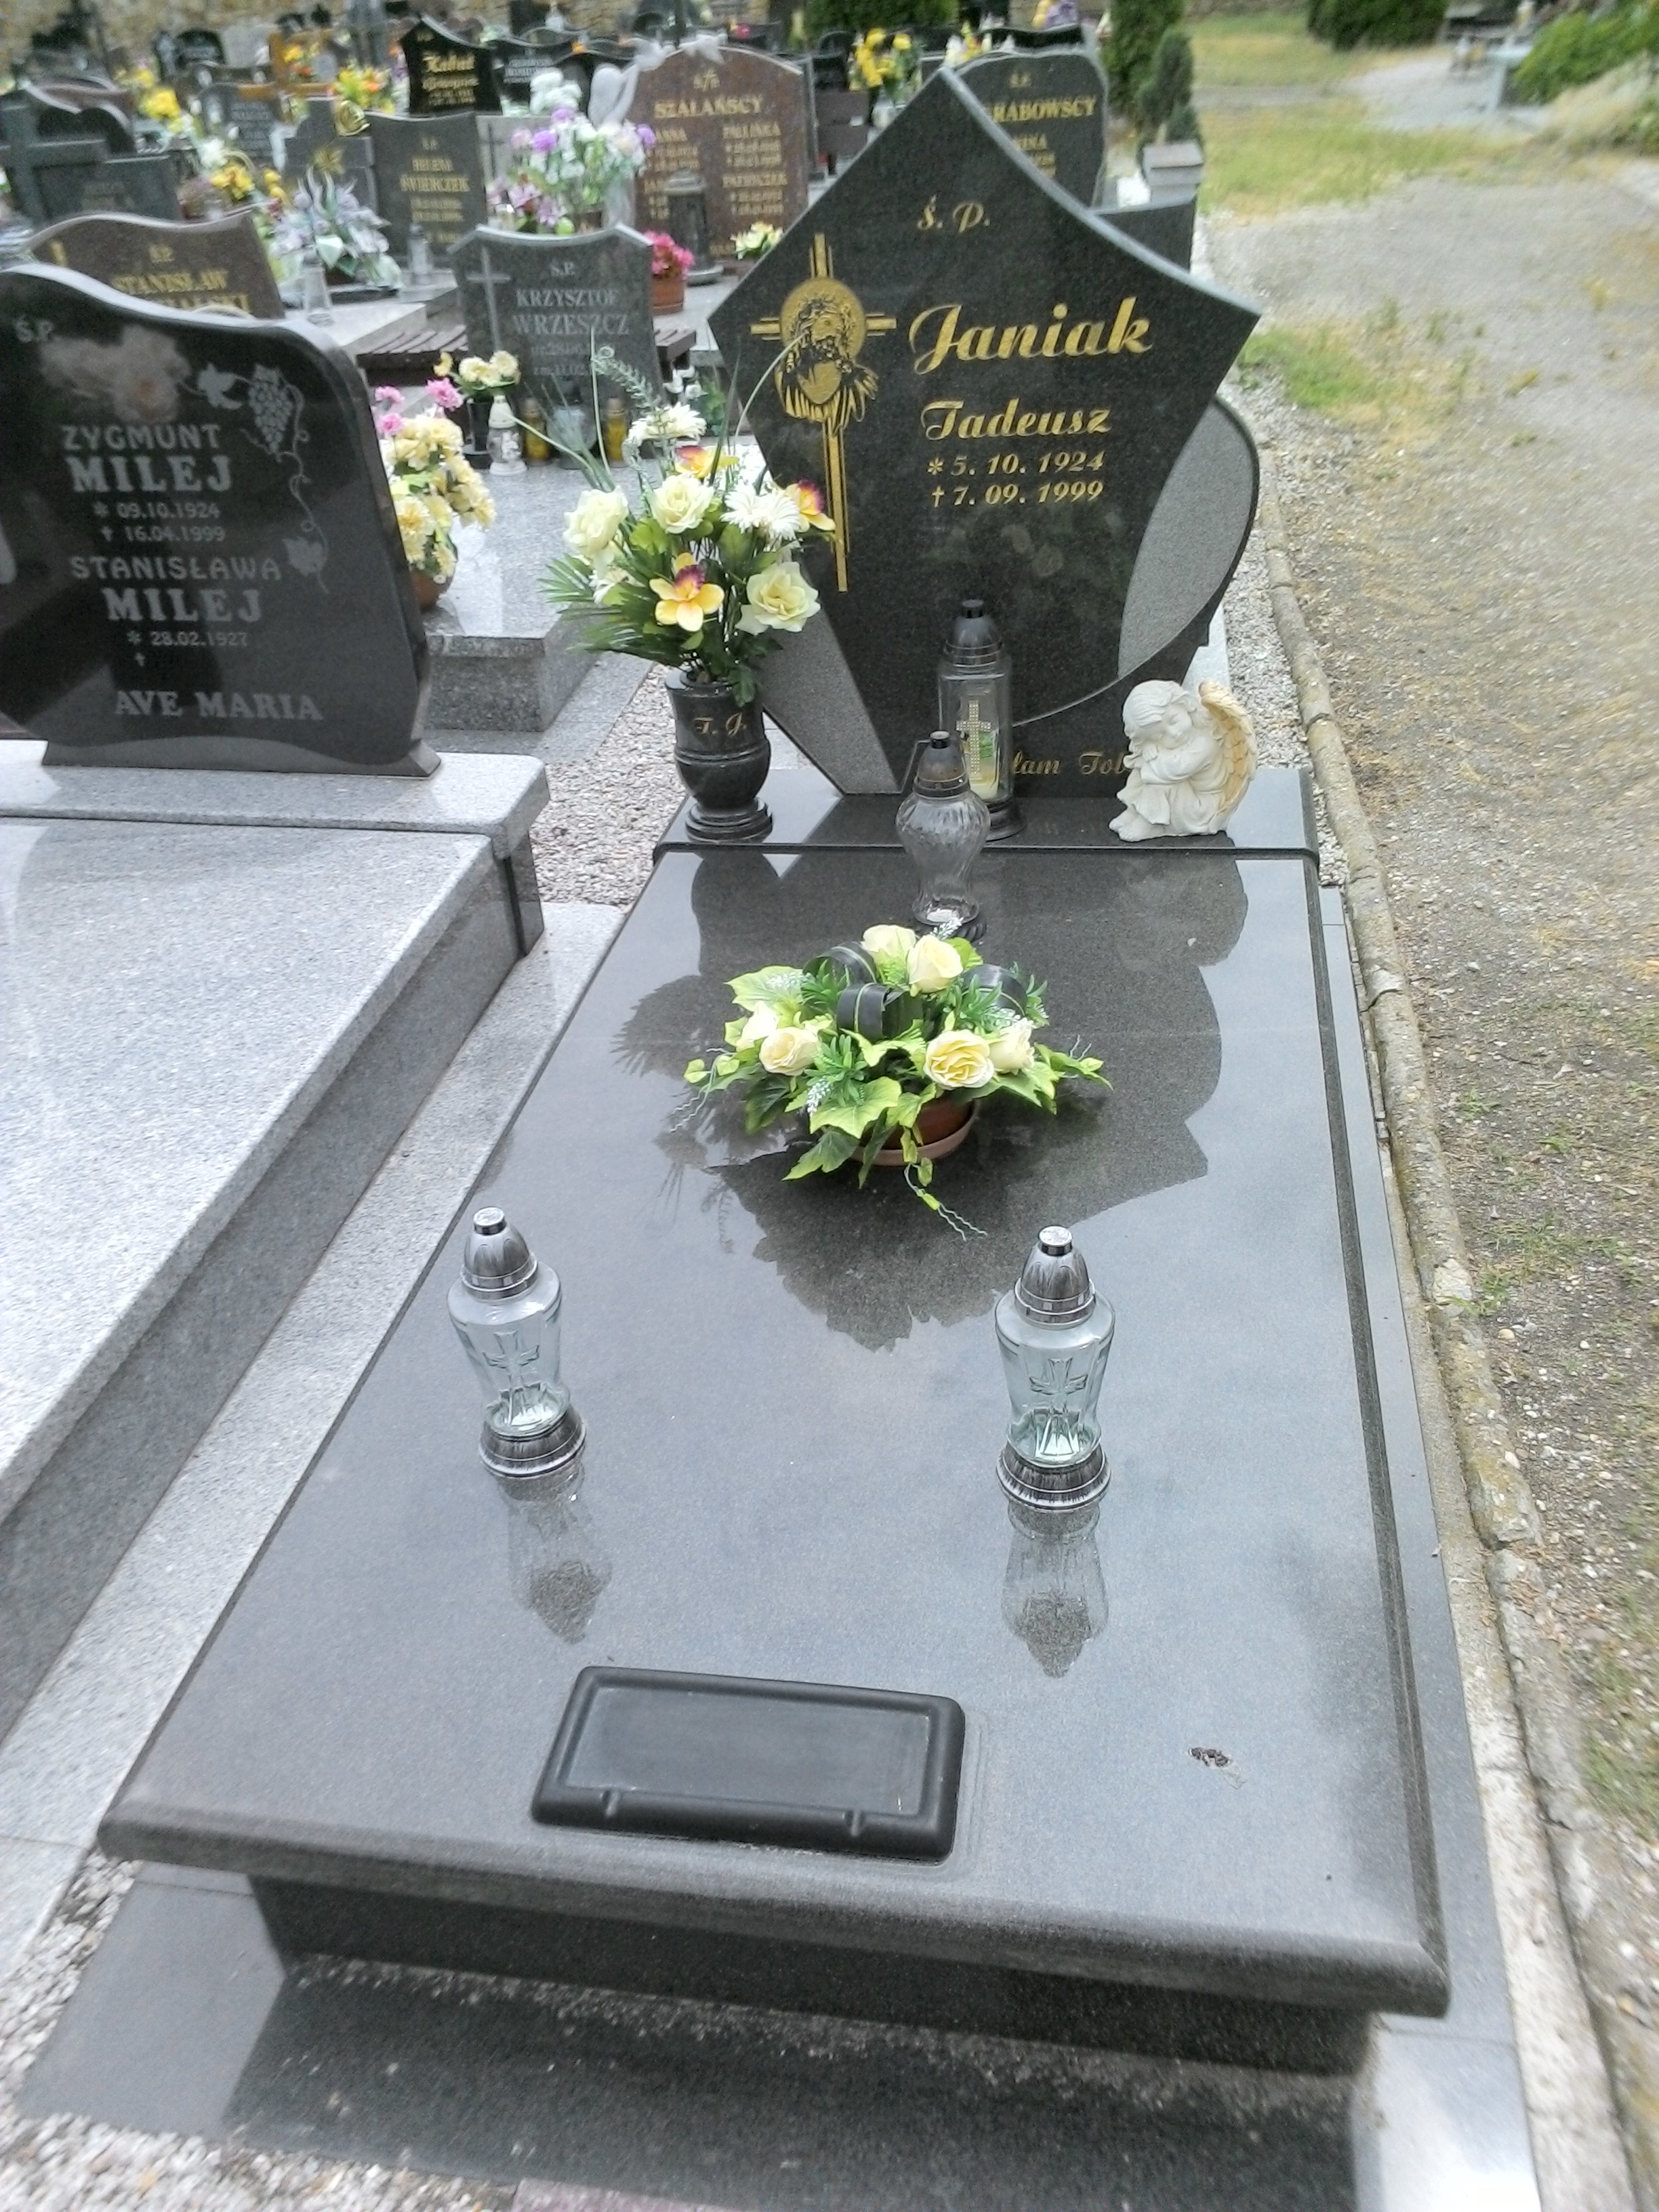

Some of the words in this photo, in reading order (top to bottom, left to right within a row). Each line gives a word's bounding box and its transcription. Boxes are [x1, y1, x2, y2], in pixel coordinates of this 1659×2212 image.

[987, 96, 1096, 122] RABOWSCY
[909, 297, 1153, 375] Janiak
[921, 398, 1111, 441] Tadeusz
[62, 424, 222, 450] ZYGMUNT
[66, 455, 232, 493] MILEJ
[951, 455, 976, 476] 5.
[987, 453, 1027, 475] 10.
[1039, 451, 1106, 474] 1924
[953, 485, 976, 507] 7.
[985, 483, 1027, 505] 09.
[1038, 480, 1104, 504] 1999
[116, 501, 221, 520] 09.10.1924
[70, 554, 283, 581] STANISŁAWA
[102, 587, 263, 623] MILEJ
[114, 689, 184, 717] AVE
[196, 691, 324, 720] MARIA
